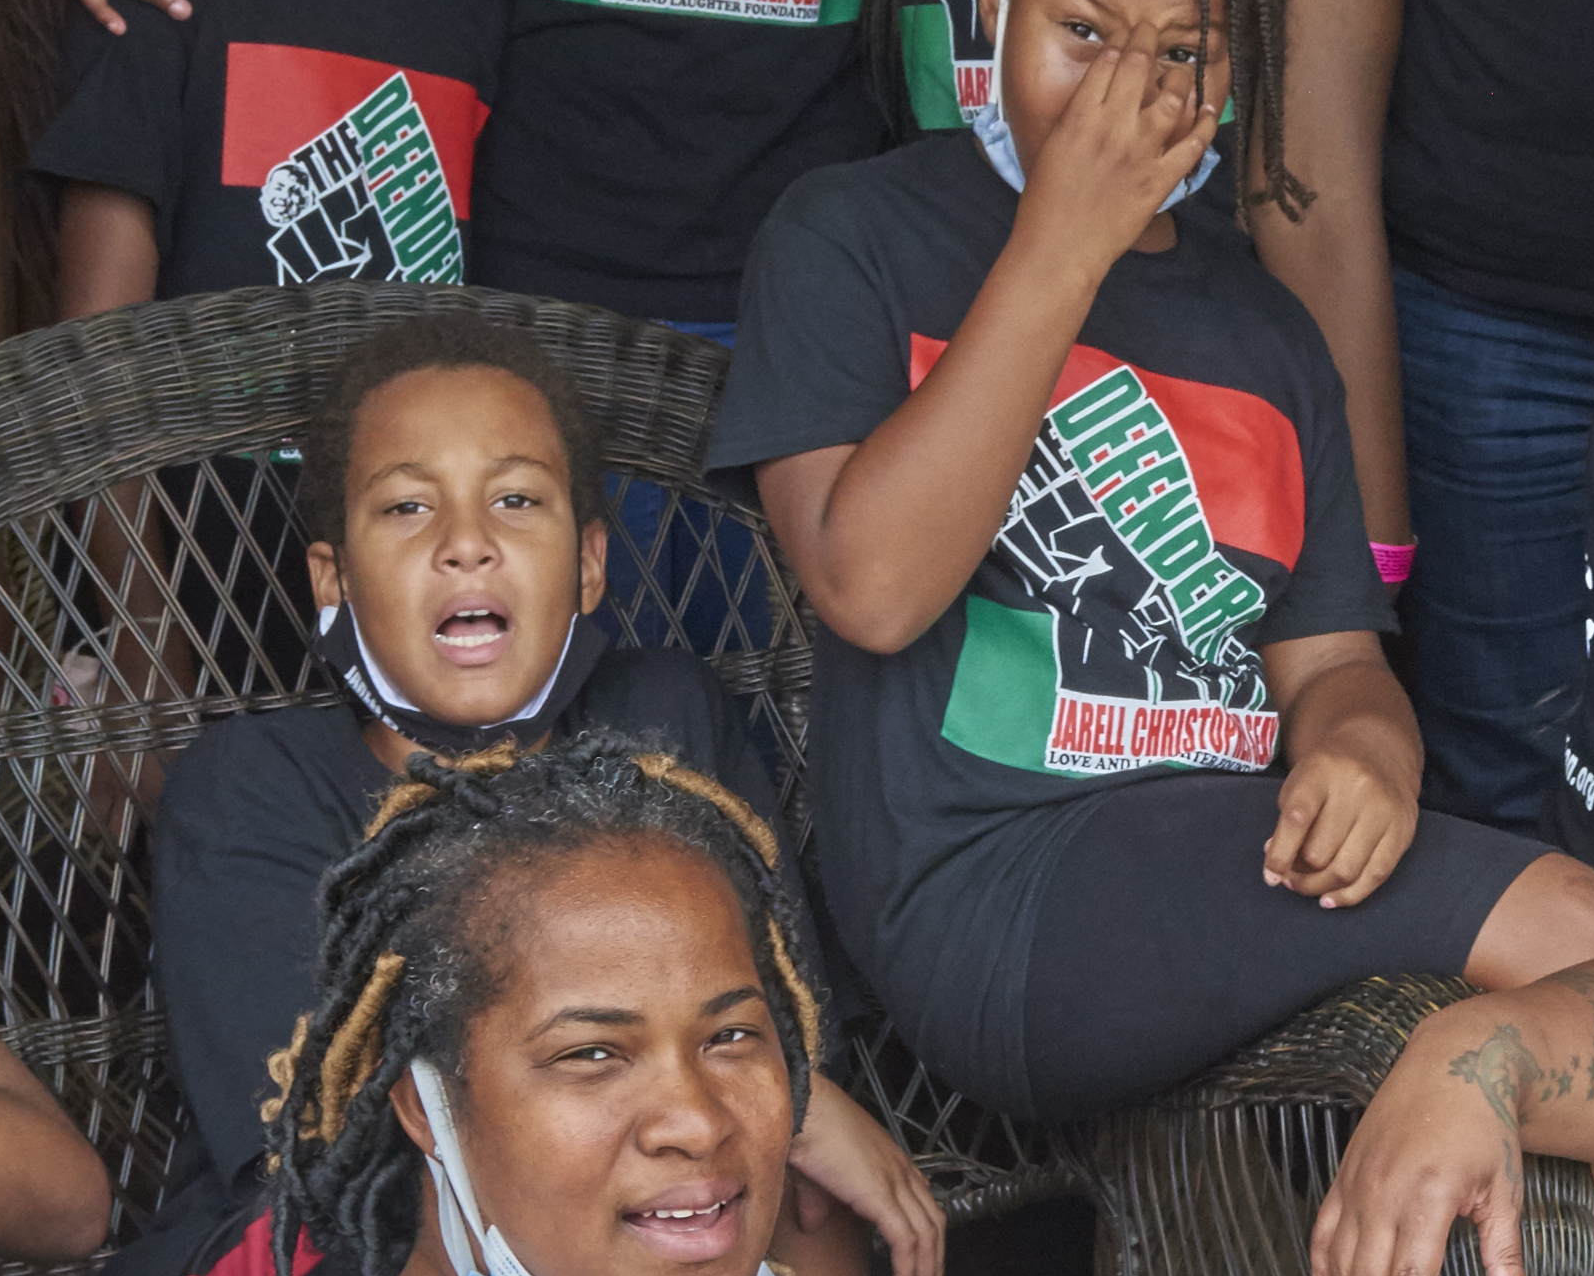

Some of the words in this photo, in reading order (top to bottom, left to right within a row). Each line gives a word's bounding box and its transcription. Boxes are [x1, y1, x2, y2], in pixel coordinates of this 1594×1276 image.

[292, 116, 363, 196] THE
[1052, 697, 1125, 755] JARELL
[1049, 751, 1091, 767] LOVE
[1096, 756, 1130, 771] AND
